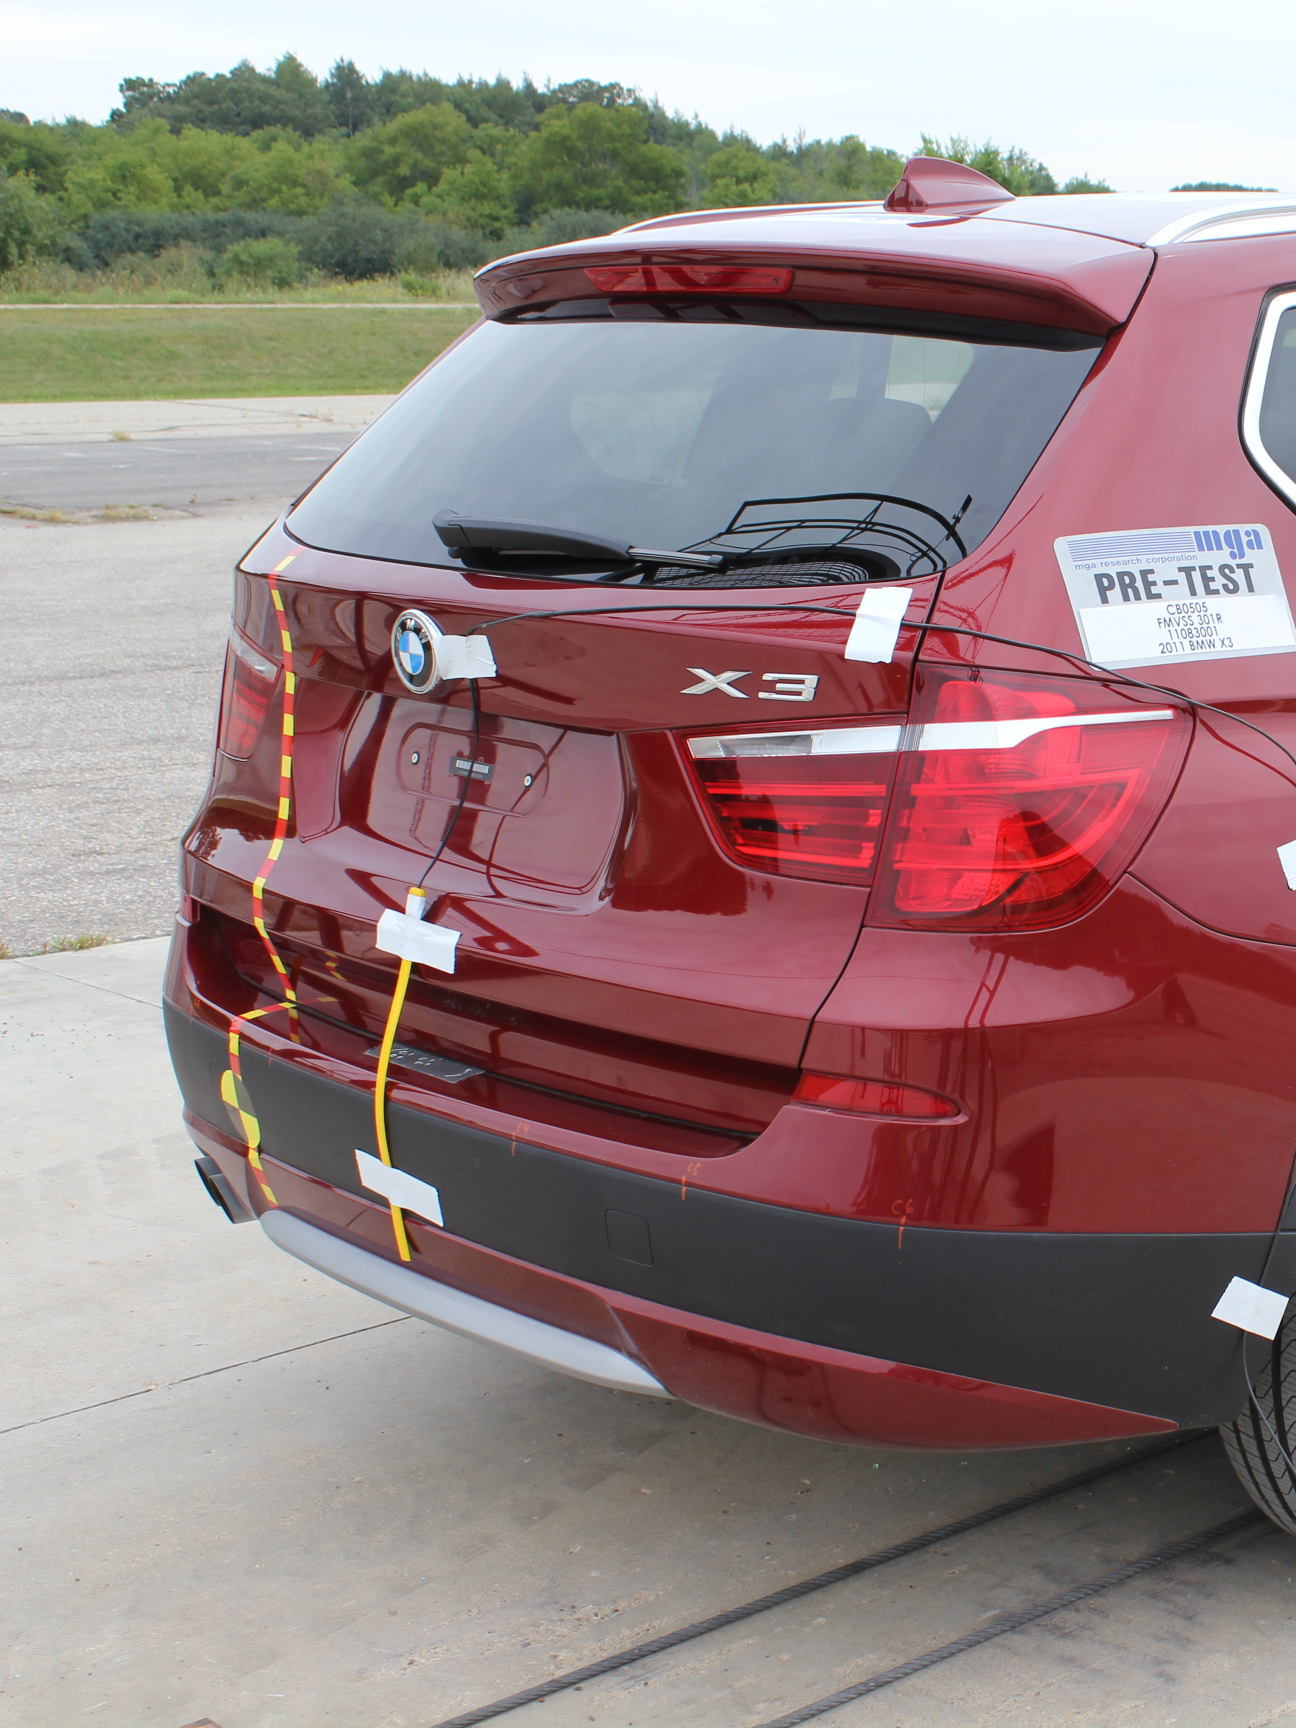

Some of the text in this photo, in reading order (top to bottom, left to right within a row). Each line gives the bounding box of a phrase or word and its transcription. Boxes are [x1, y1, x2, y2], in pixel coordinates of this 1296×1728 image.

[1193, 528, 1264, 560] mga
[1074, 553, 1199, 571] mga research corporation
[1093, 562, 1256, 605] PRE-TEST
[1166, 601, 1208, 616] CB0505
[1156, 613, 1223, 629] FMVSS 301R
[1167, 625, 1219, 641] 11083001
[1158, 636, 1235, 655] 2011 BMW X3
[891, 1198, 914, 1214] C6
